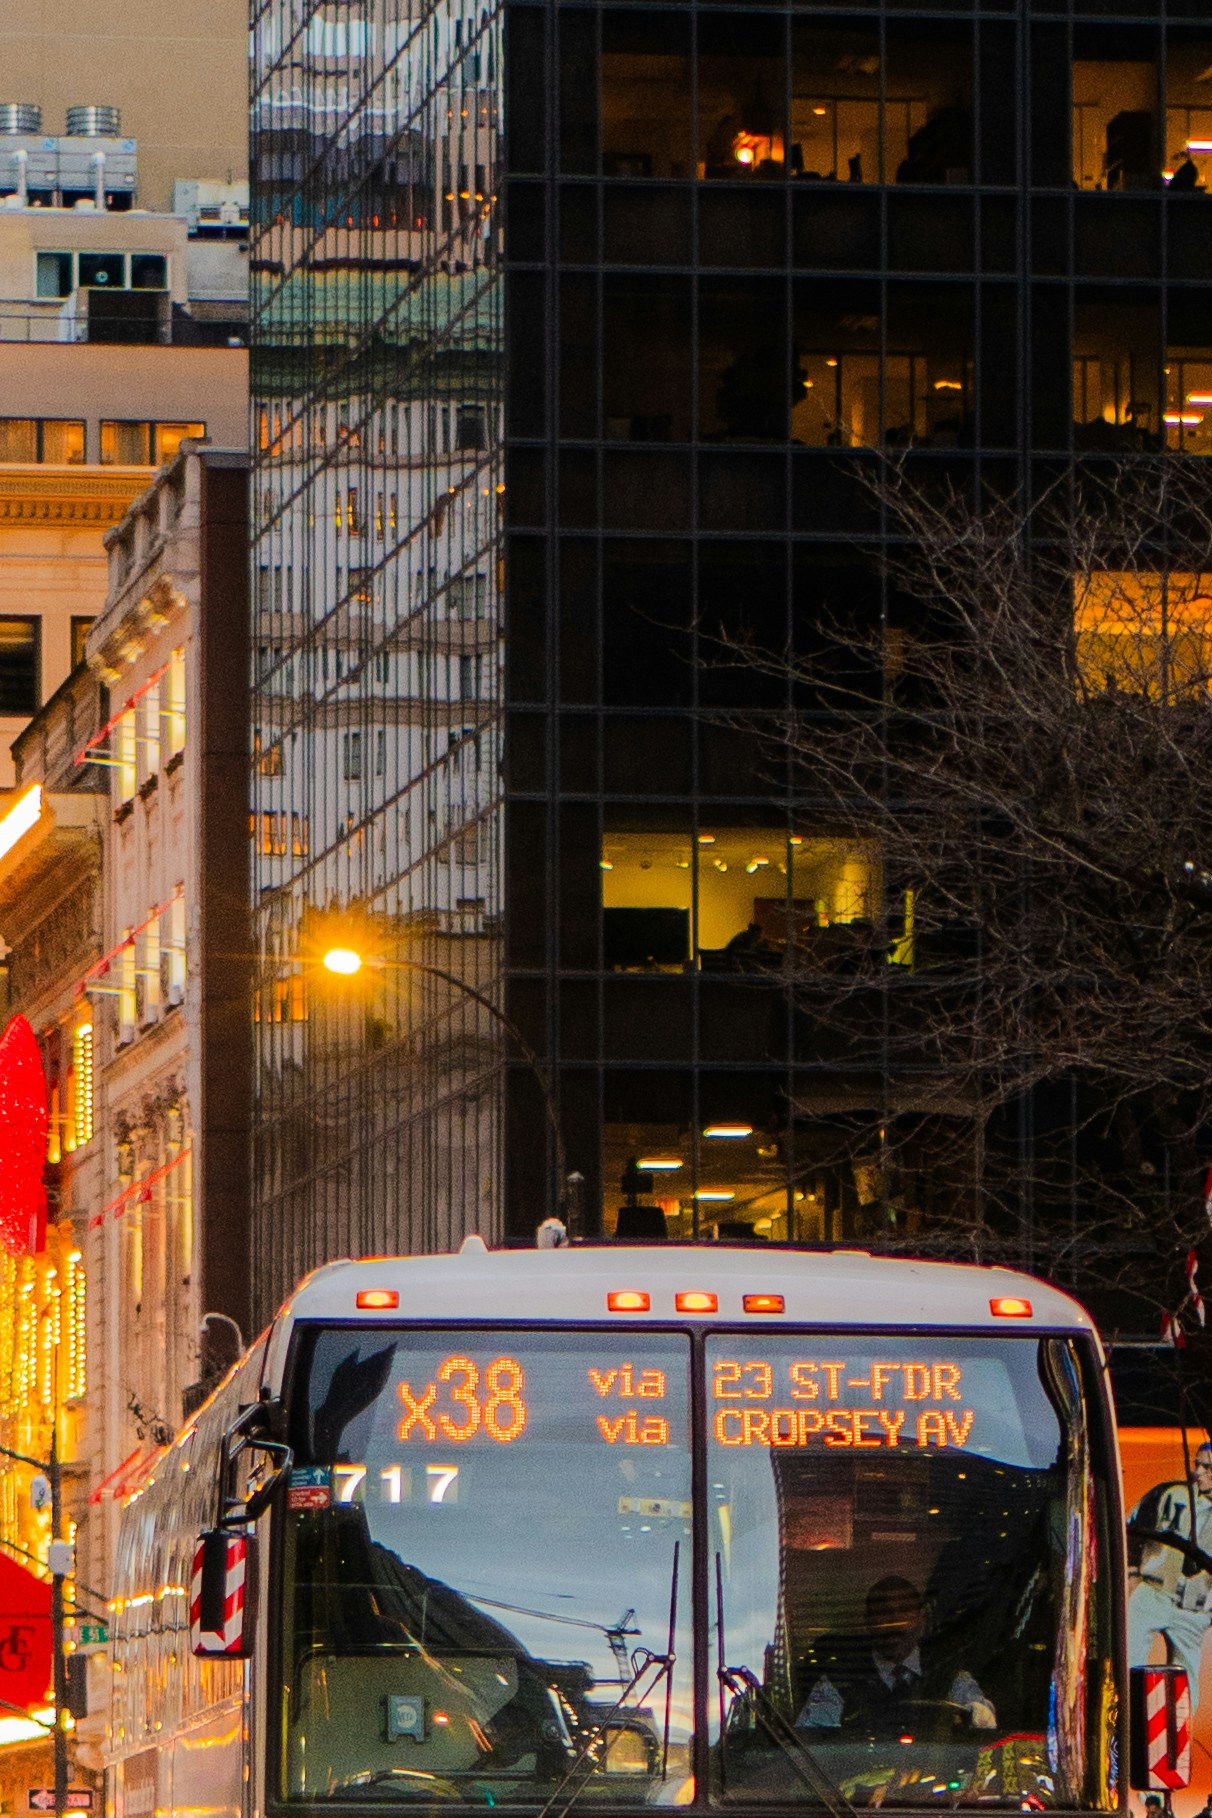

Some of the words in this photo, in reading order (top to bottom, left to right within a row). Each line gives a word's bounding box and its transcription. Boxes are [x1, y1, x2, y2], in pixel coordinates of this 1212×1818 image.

[398, 1355, 528, 1443] x38
[587, 1362, 666, 1399] via
[713, 1361, 773, 1400] 23
[790, 1361, 962, 1401] ST-FDR
[597, 1410, 670, 1445] via
[714, 1408, 906, 1447] CROPSEY
[916, 1409, 975, 1447] AV
